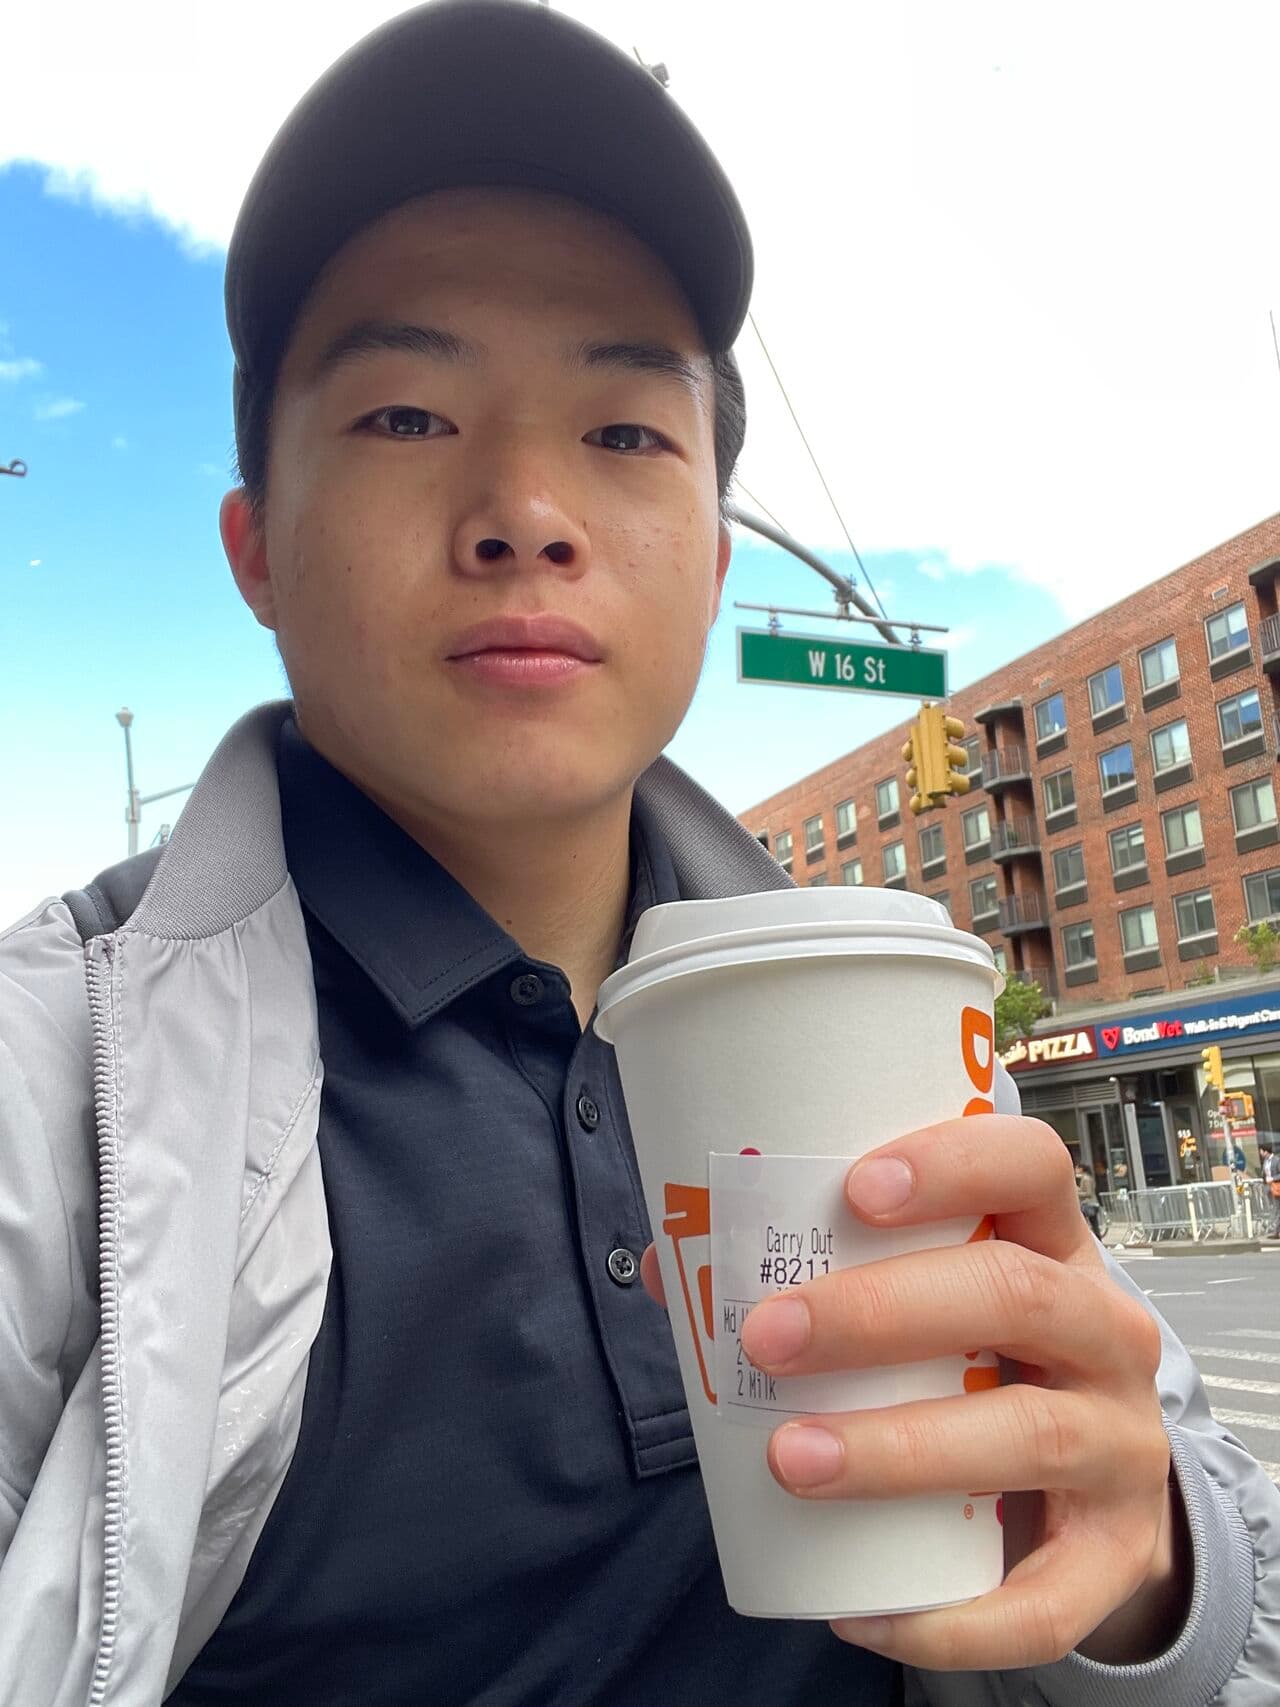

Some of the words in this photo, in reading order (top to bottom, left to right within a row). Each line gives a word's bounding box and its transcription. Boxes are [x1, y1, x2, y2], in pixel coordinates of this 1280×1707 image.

[808, 650, 826, 678] W
[834, 653, 856, 681] 16
[863, 656, 886, 684] St
[1027, 1032, 1093, 1063] PIZZA
[766, 1226, 804, 1257] Carry
[811, 1227, 833, 1255] Out
[760, 1257, 829, 1285] #8211
[723, 1305, 737, 1333] Md
[736, 1338, 743, 1366] 2
[737, 1369, 744, 1396] 2
[749, 1370, 777, 1401] Milk
